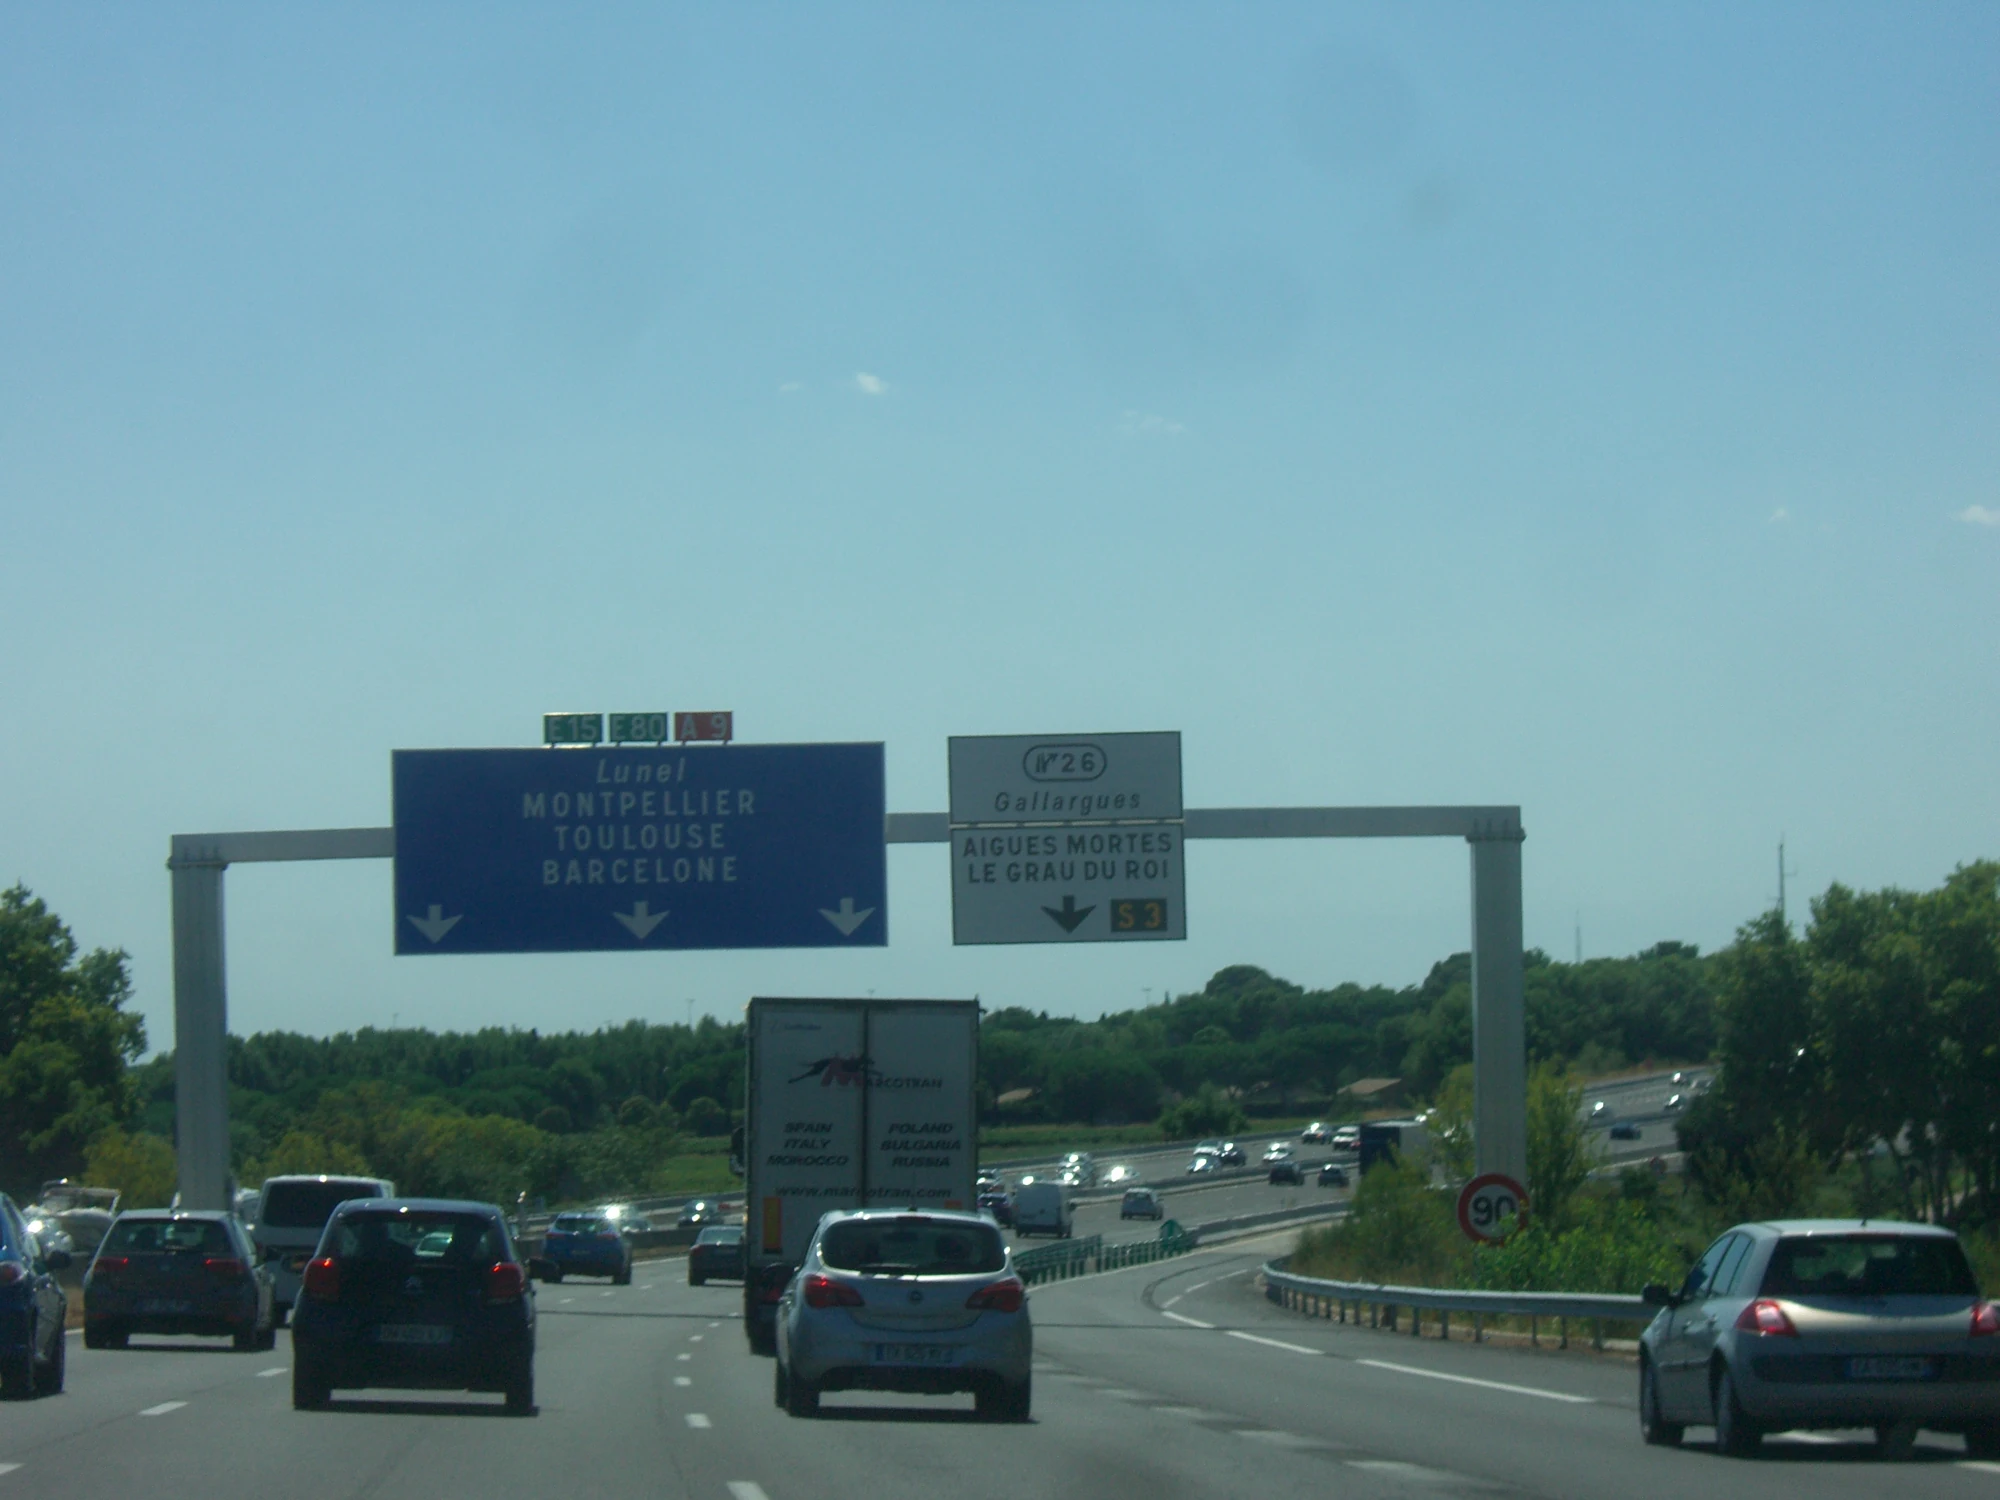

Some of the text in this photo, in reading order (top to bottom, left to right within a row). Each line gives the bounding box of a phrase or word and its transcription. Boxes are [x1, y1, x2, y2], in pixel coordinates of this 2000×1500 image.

[549, 715, 598, 741] E15
[612, 715, 666, 740] E80
[596, 757, 687, 784] Lunel
[522, 789, 755, 819] MONTPELLIER
[994, 791, 1142, 816] Gallargues
[554, 823, 726, 851] TOULOUSE
[963, 832, 1173, 857] AIGUES MORTES
[542, 857, 738, 885] BARCELONE
[968, 859, 1168, 883] LE GRAU DU ROI
[784, 1122, 833, 1134] SPAIN
[888, 1122, 954, 1134] POLAND
[784, 1138, 832, 1150] ITALY
[880, 1139, 961, 1151] BULGARIA
[766, 1155, 848, 1167] MOROCCO
[891, 1156, 951, 1168] RUSSIA
[775, 1186, 953, 1199] www.marotran.com
[1473, 1196, 1516, 1226] 90
